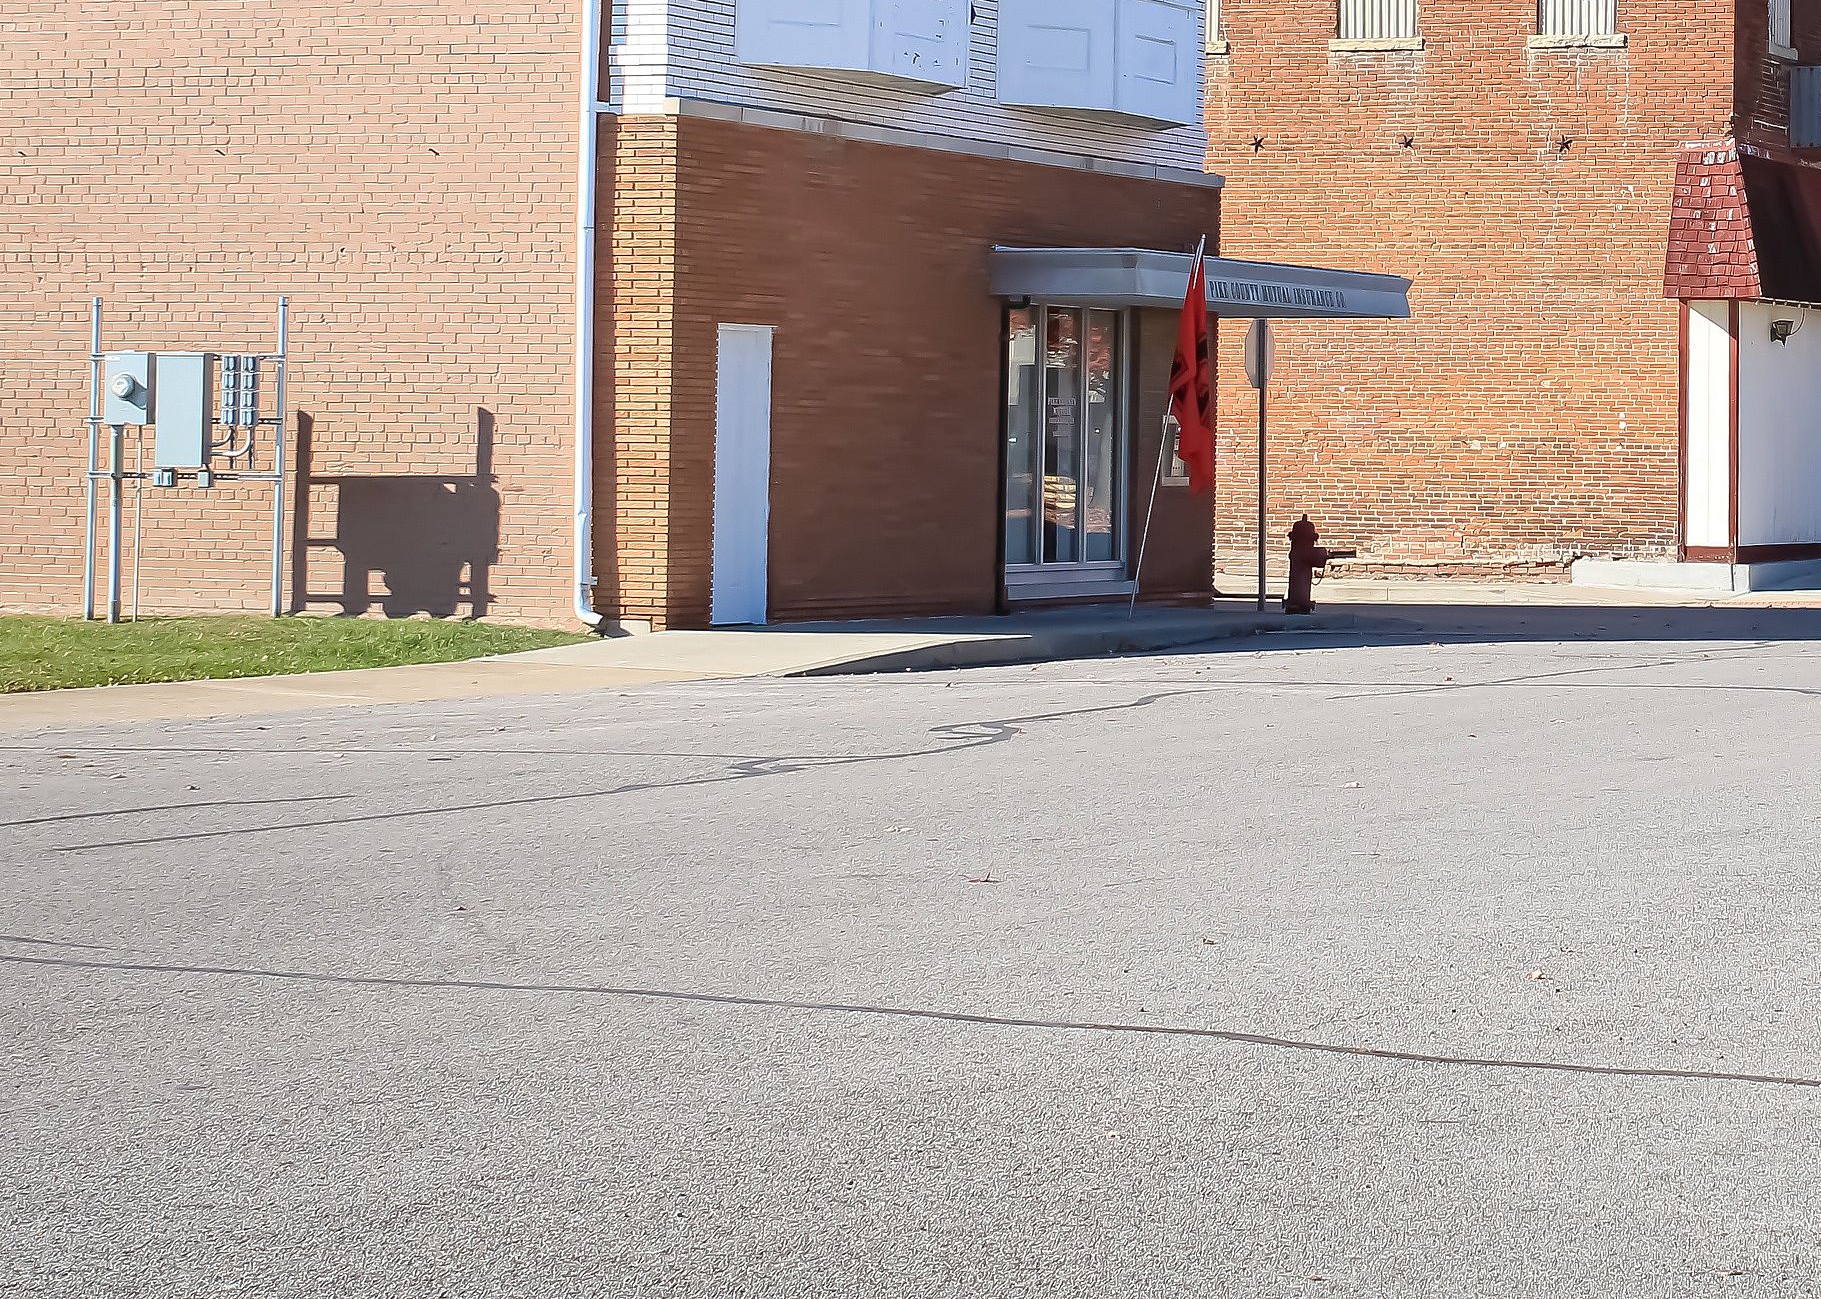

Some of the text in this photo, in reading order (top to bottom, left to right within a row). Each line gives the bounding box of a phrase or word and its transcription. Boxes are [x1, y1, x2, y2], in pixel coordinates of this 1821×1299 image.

[1209, 280, 1228, 299] PIKE
[1230, 281, 1260, 301] COUNTY
[1261, 284, 1292, 304] MUTUAL
[1293, 287, 1334, 308] INSURANCE
